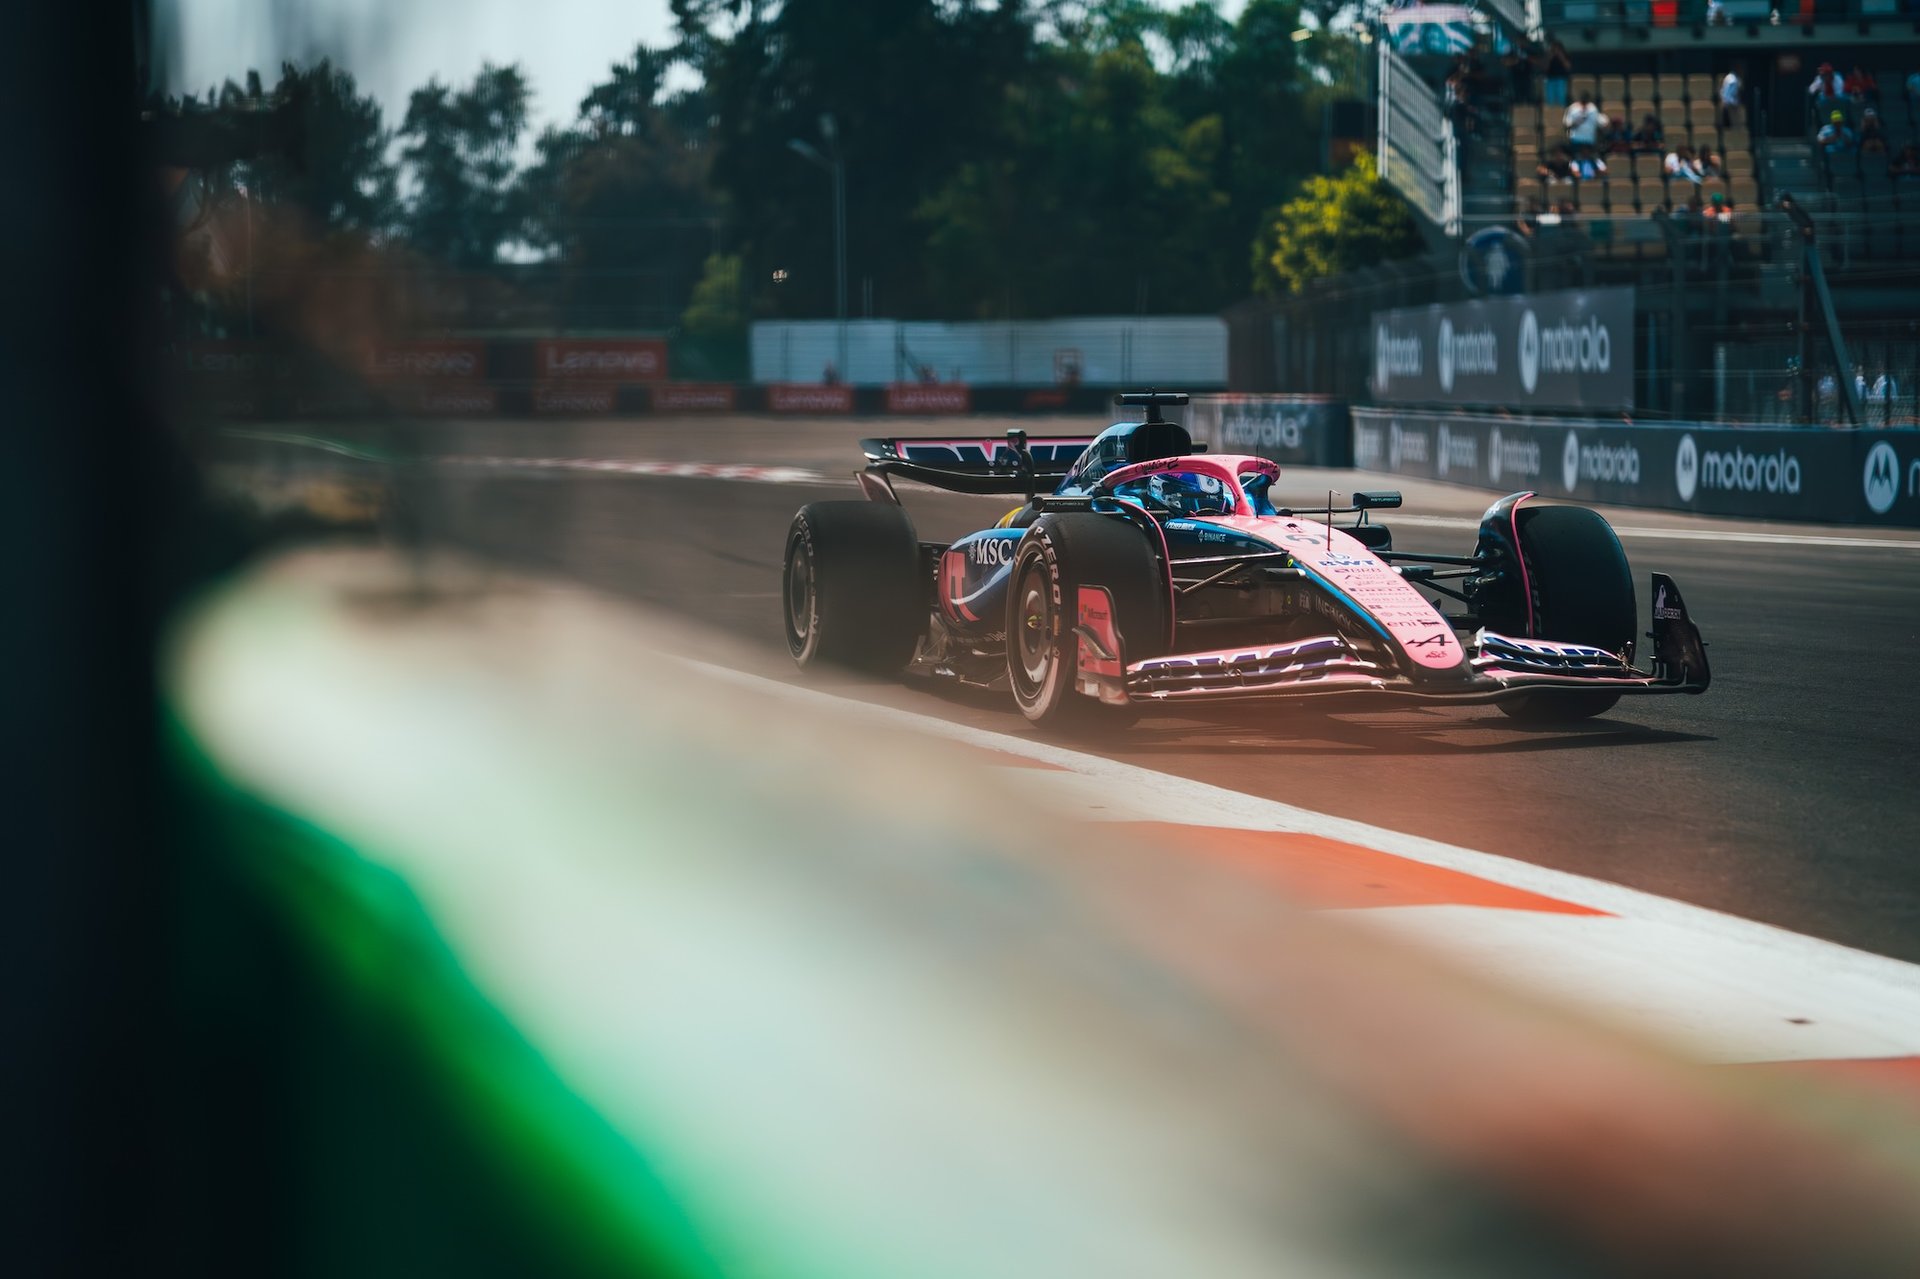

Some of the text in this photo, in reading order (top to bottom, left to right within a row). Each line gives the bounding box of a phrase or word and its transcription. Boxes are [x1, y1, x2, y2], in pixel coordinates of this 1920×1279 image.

[1541, 315, 1611, 373] motorola
[546, 347, 658, 374] Lenovo
[1702, 444, 1800, 494] motorola
[1204, 532, 1226, 543] BINANCE
[976, 538, 1013, 566] MSC
[1318, 559, 1375, 567] BWT
[1041, 534, 1062, 606] ZERO
